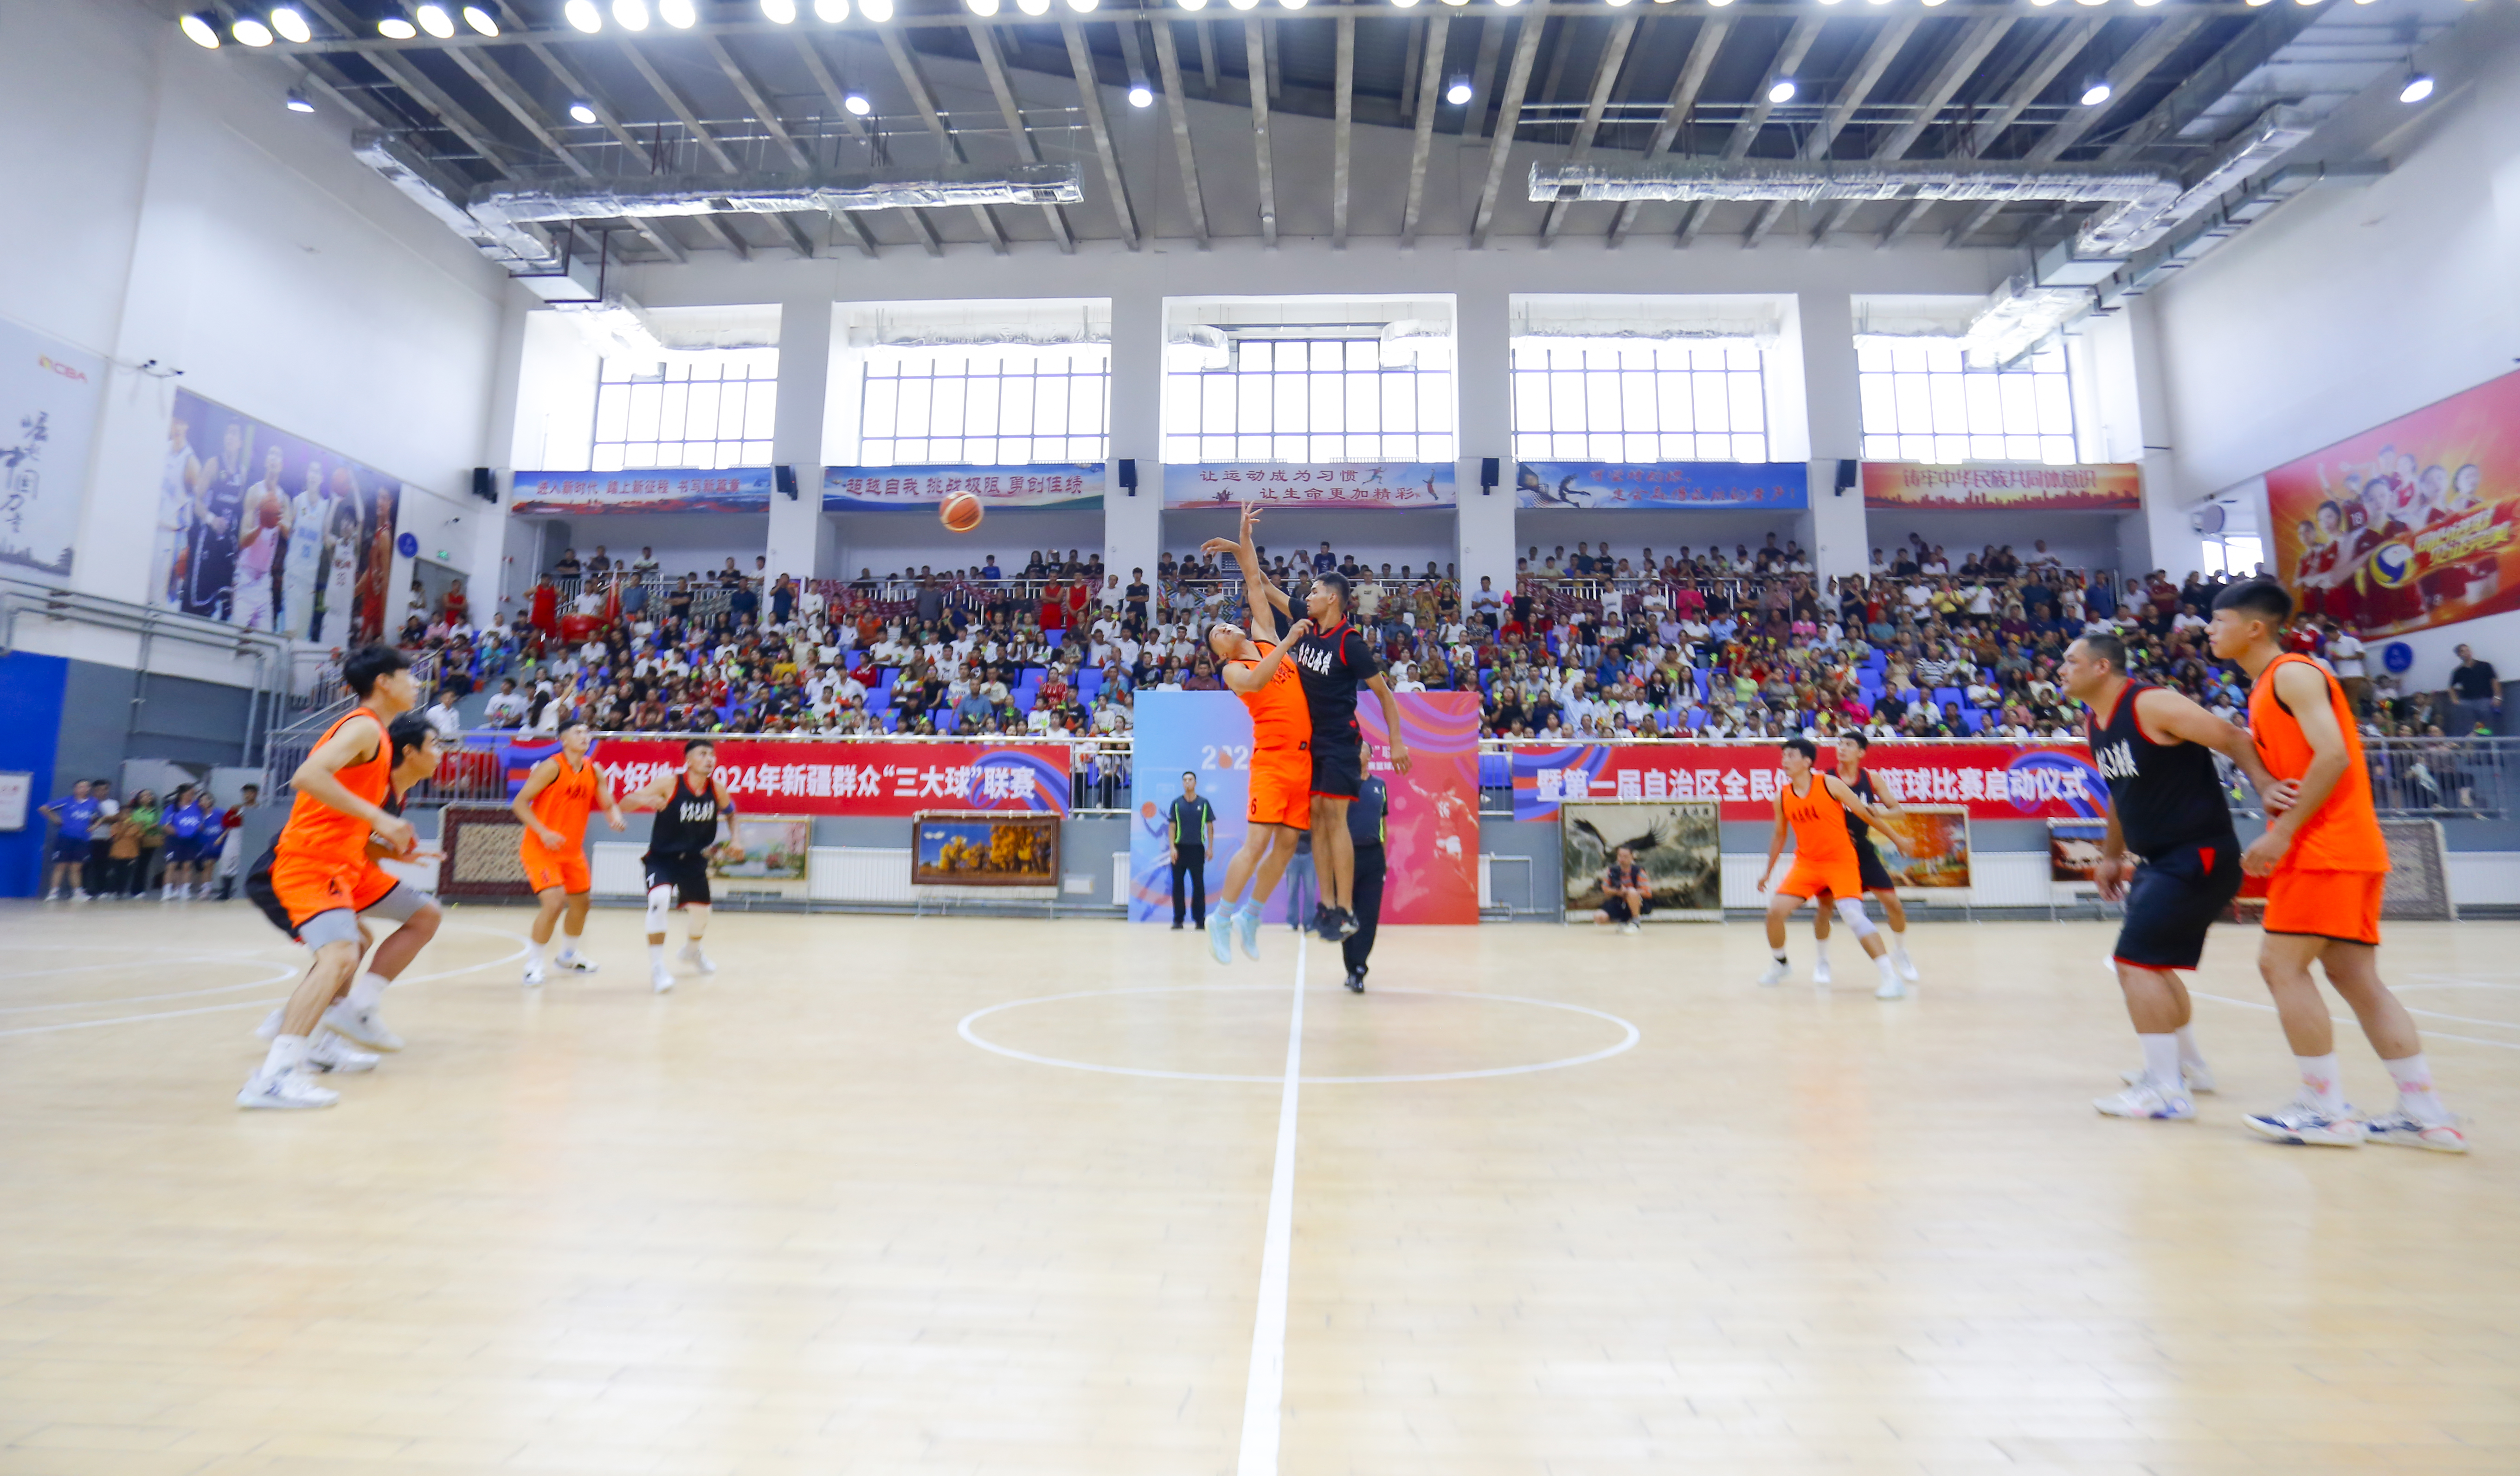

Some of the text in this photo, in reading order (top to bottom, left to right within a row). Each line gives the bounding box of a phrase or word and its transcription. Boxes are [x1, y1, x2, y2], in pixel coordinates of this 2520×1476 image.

[1200, 470, 1359, 482] 让运动成为习惯
[846, 477, 919, 496] 超越自我
[1009, 475, 1083, 495] 勇创佳绩
[1260, 487, 1416, 501] 让生命更加精彩
[1251, 798, 1257, 815] 6
